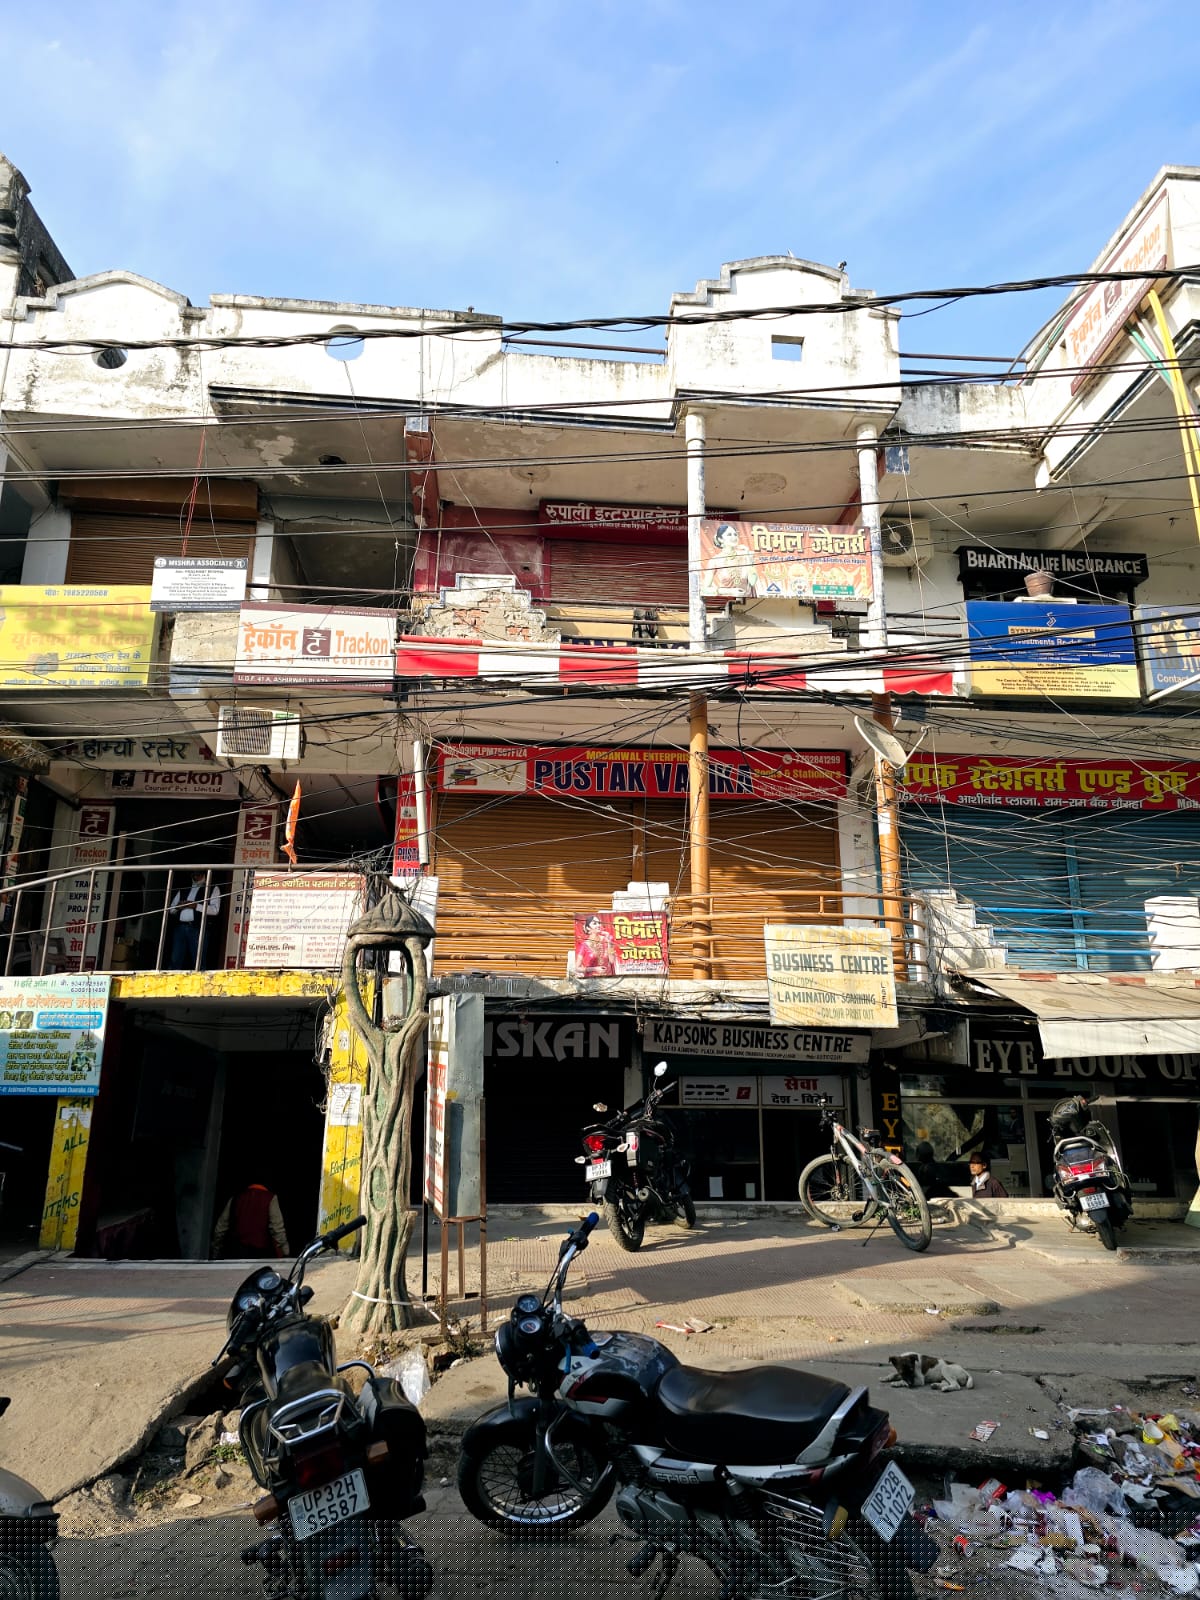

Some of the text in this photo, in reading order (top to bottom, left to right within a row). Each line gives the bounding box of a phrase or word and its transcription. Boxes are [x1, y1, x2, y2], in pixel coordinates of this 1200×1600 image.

[752, 526, 803, 553] विमल
[967, 551, 1018, 569] BHARTI
[1062, 554, 1142, 575] INSURANCE
[336, 630, 389, 655] Trackon
[142, 738, 189, 760] स्टोर
[143, 770, 223, 785] Trackon
[535, 760, 645, 793] PUSTAK
[653, 763, 754, 794] VAIKA
[1076, 769, 1133, 794] एण्ड
[1140, 771, 1188, 803] बुक
[75, 847, 108, 858] Trackon
[613, 916, 663, 940] विमल
[772, 953, 889, 975] BUSINESS CENTRE
[777, 991, 837, 1004] LAMINATION
[653, 1023, 854, 1053] KAPSONS BUSINESS CENTRE
[973, 1039, 1038, 1074] EYE
[1054, 1056, 1146, 1079] LOOK
[784, 1075, 819, 1091] सेवा
[771, 1093, 791, 1104] देश
[63, 1133, 87, 1152] ALL
[44, 1192, 80, 1220] ITEMS
[302, 1475, 356, 1512] UP32H
[871, 1470, 901, 1515] UP32B
[307, 1494, 358, 1531] S5587
